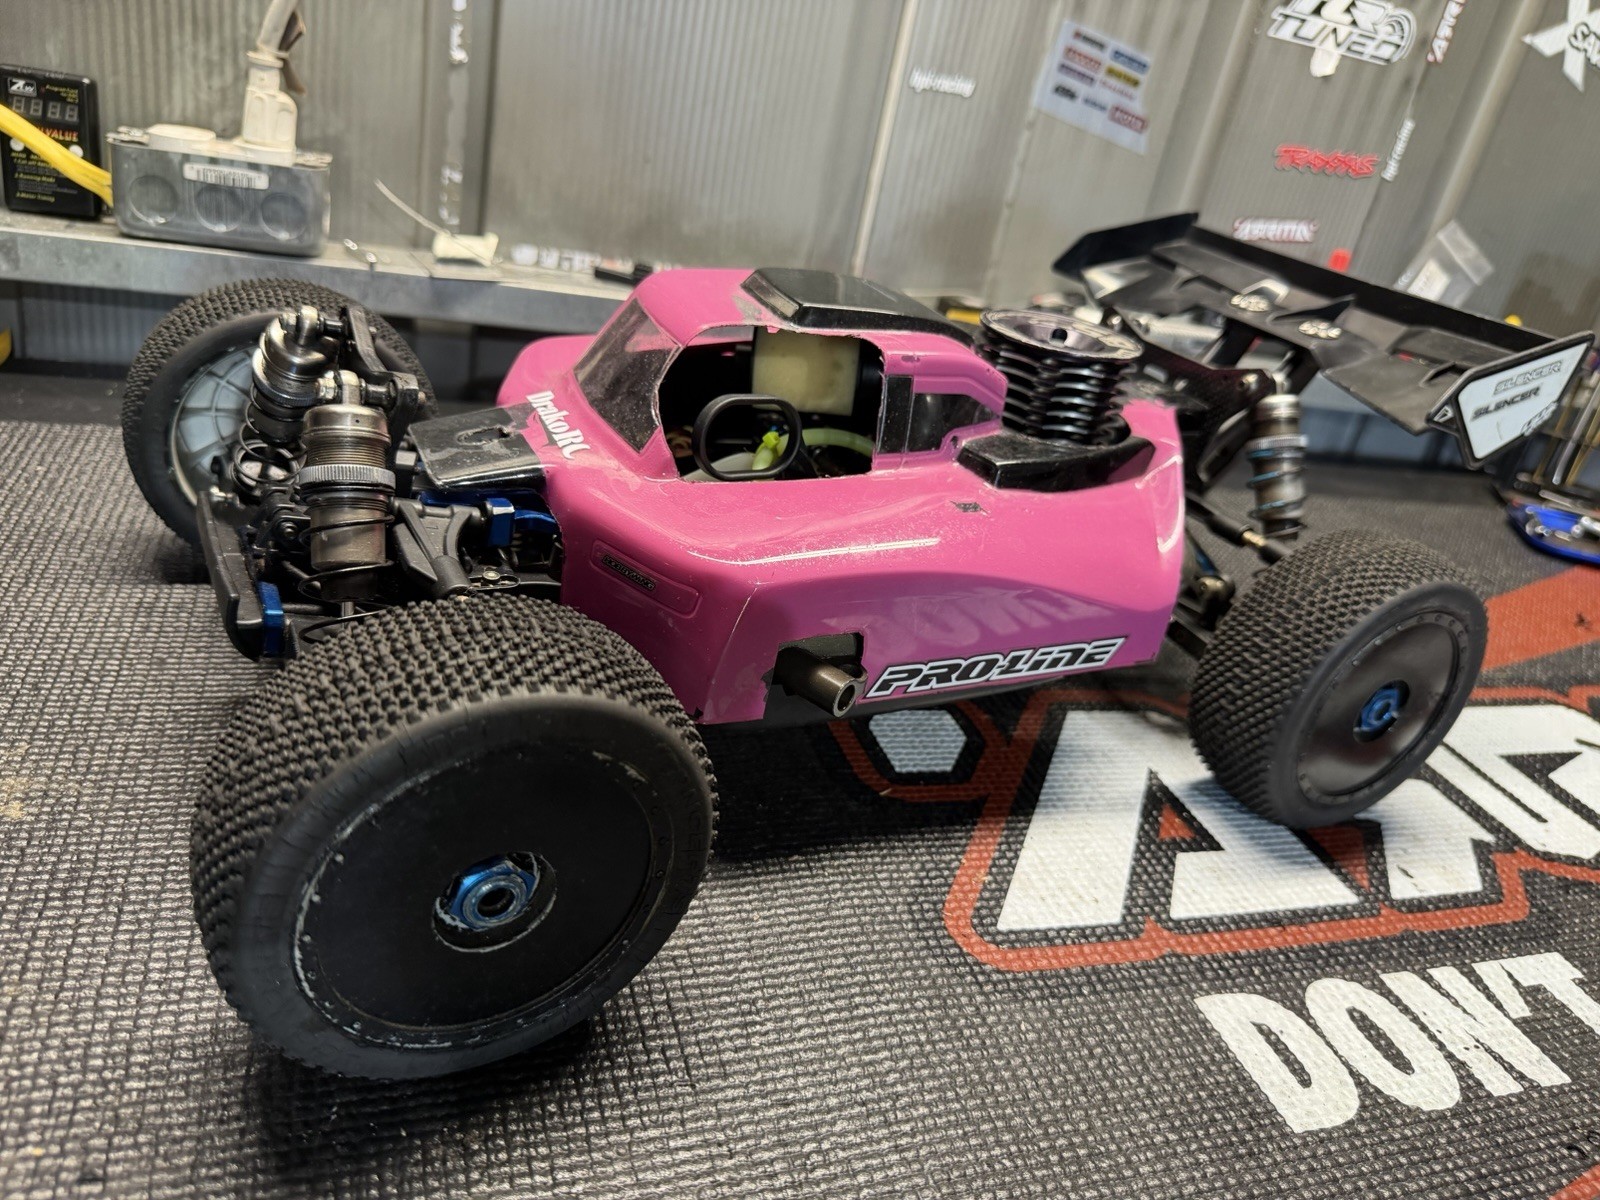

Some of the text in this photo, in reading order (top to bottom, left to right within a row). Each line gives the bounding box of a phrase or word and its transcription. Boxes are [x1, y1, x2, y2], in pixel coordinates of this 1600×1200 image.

[1269, 14, 1404, 64] TUNED
[1275, 145, 1380, 178] TRAXXAS
[525, 390, 591, 460] DrakoRC
[1470, 385, 1542, 422] SILENCER
[1193, 951, 1600, 1133] DON'T
